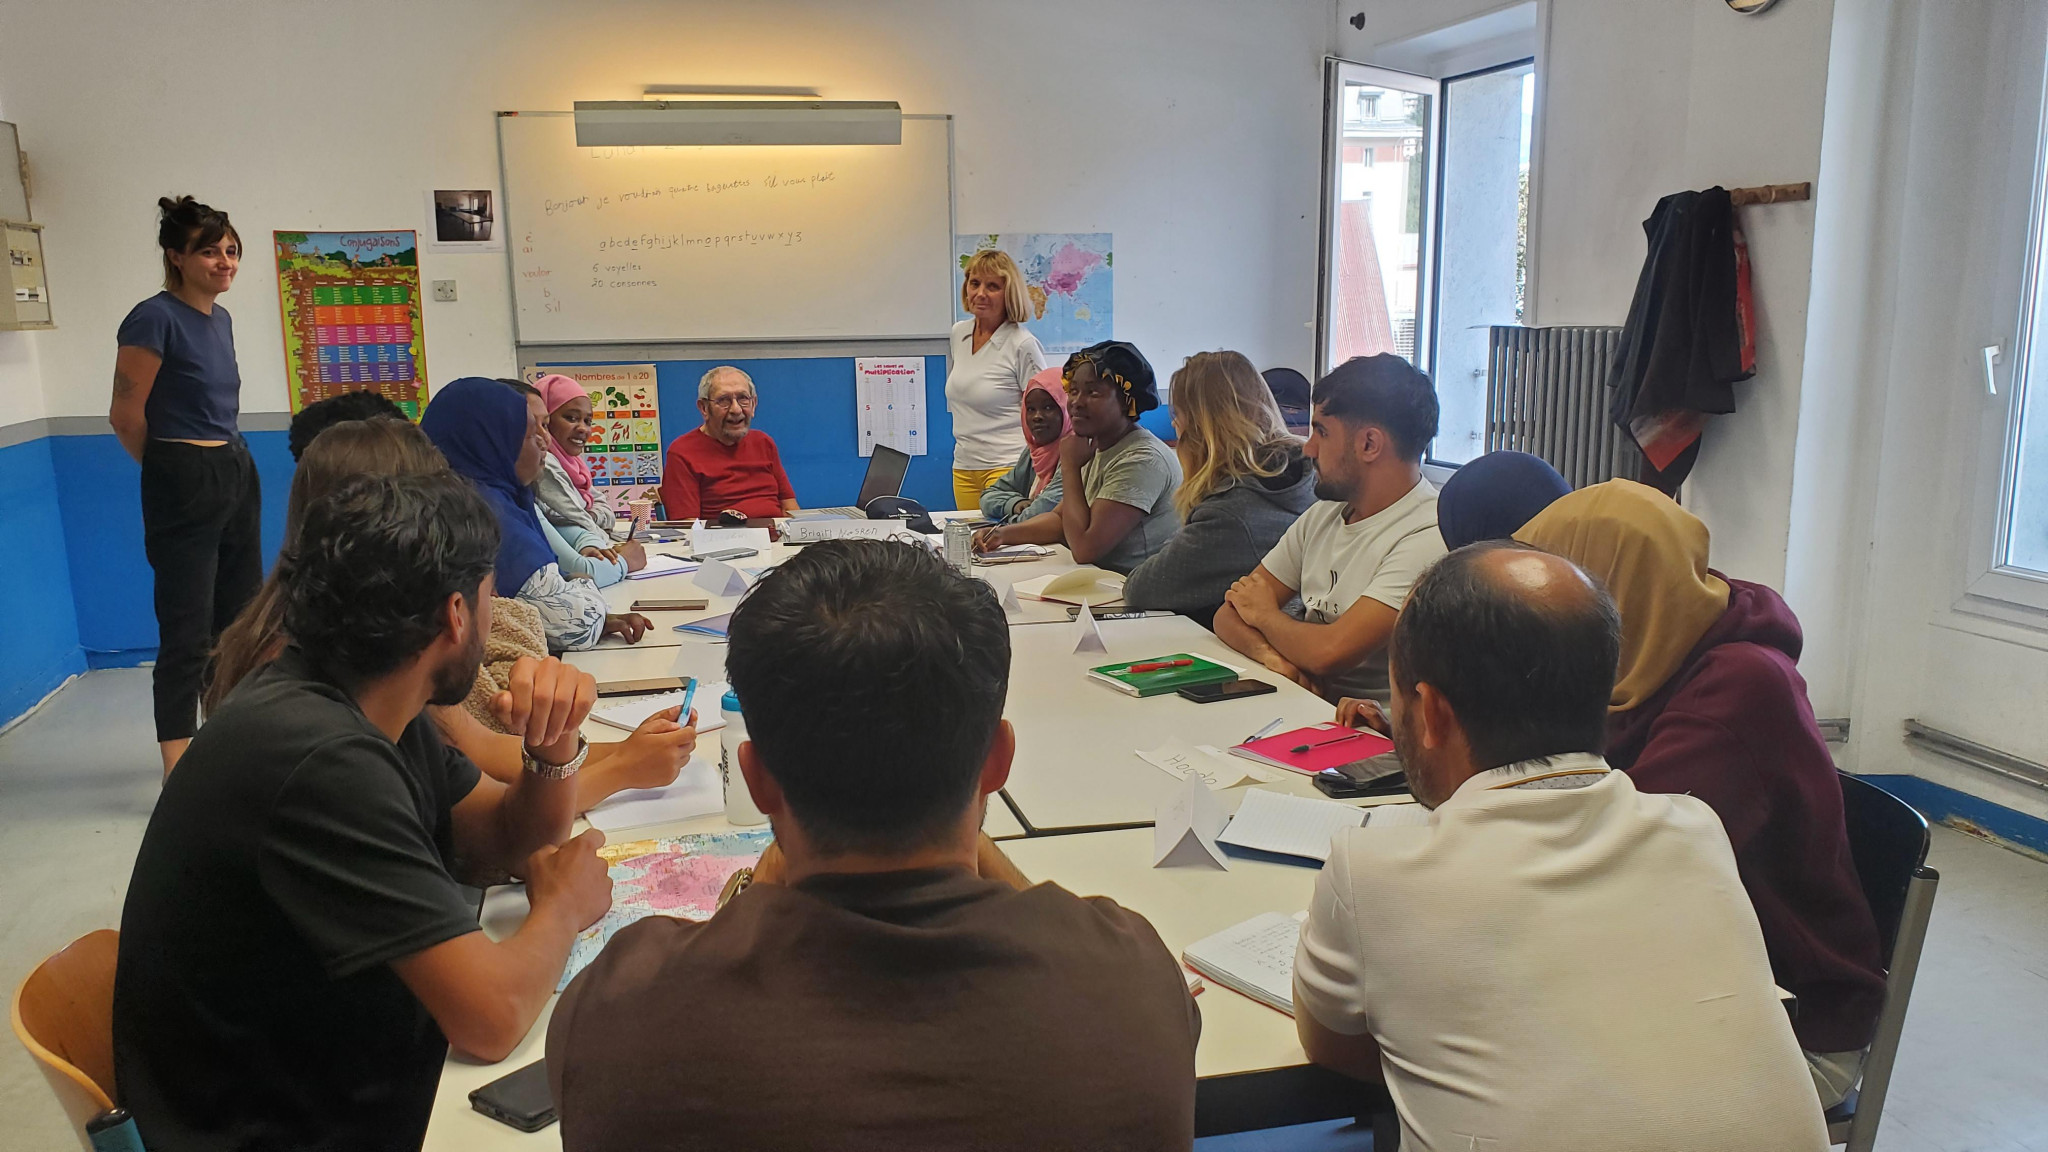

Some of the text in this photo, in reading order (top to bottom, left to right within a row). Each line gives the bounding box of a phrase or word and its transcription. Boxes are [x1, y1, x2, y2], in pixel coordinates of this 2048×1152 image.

[544, 195, 589, 216] Bonjour
[596, 196, 610, 210] je
[339, 235, 401, 252] Conjugaisons
[605, 262, 642, 275] voyelles
[591, 277, 657, 288] 20 consonnes
[574, 372, 616, 381] Nombres
[638, 371, 649, 380] 20
